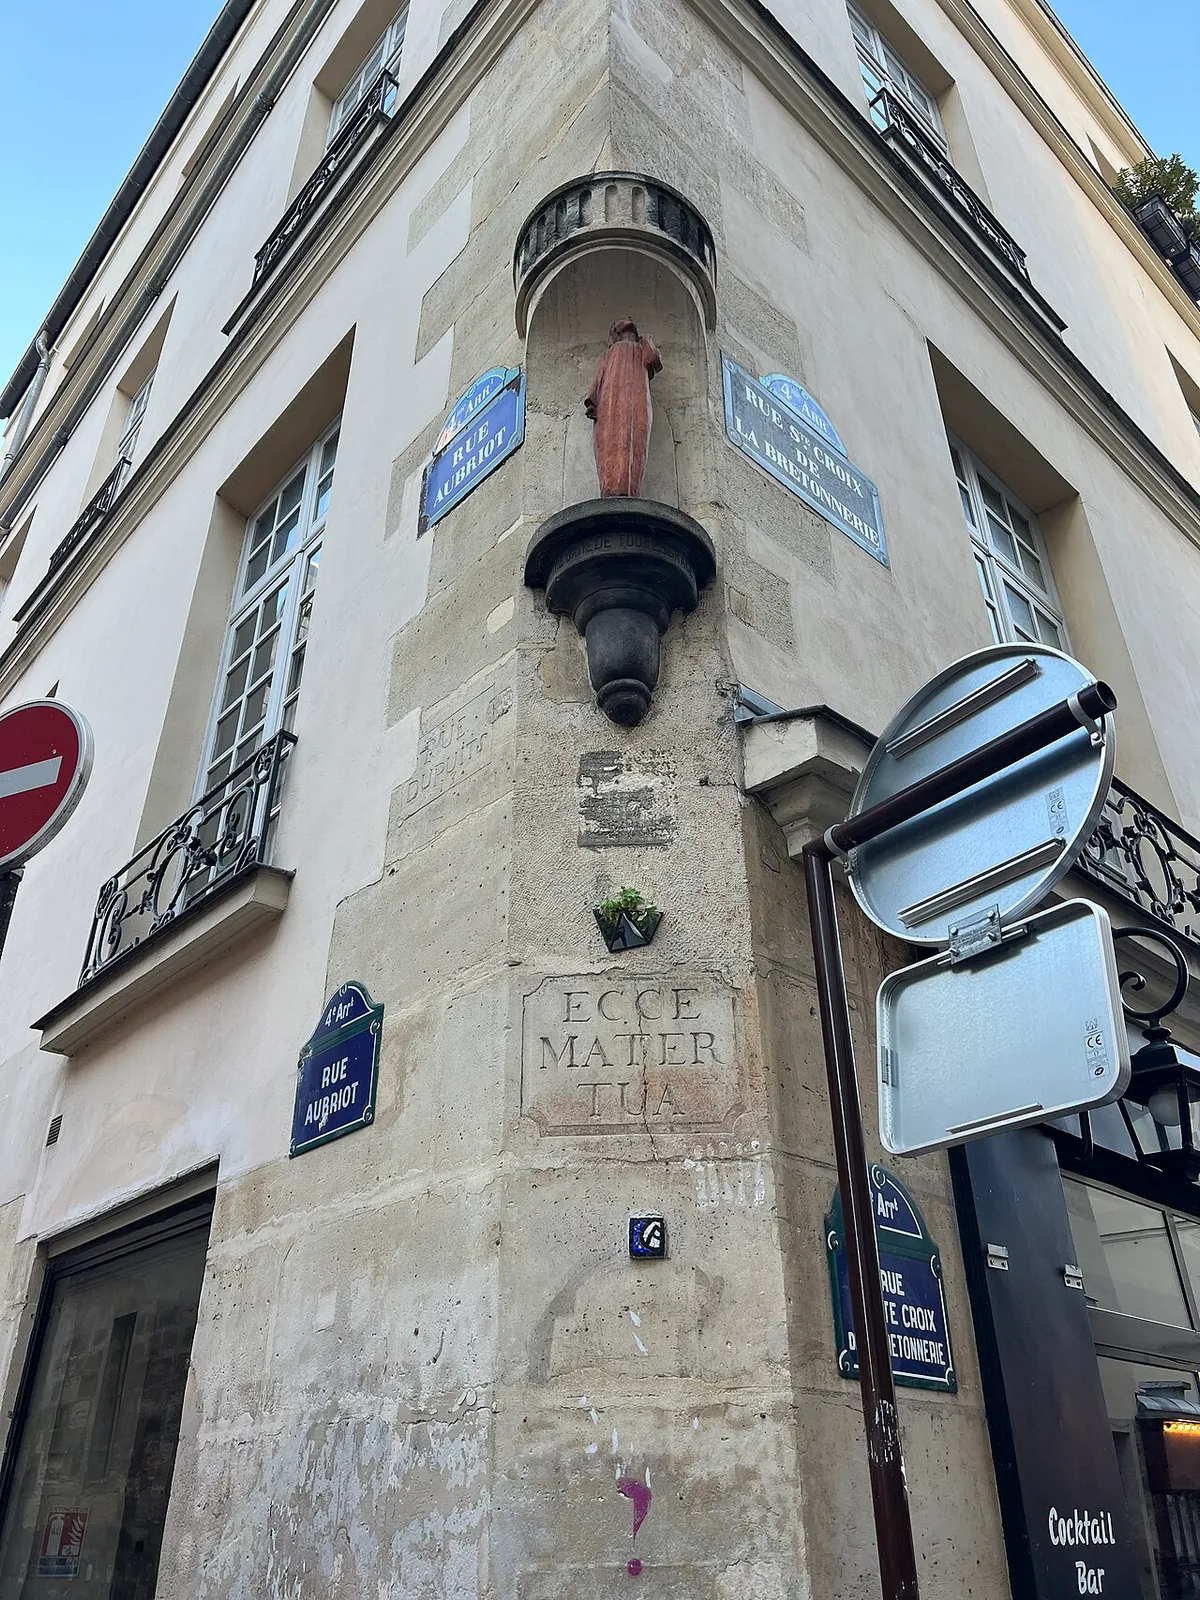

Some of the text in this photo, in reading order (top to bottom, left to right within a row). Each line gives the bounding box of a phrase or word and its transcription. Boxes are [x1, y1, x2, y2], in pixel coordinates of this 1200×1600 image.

[452, 420, 489, 469] RUE
[744, 385, 784, 430] RUE
[813, 444, 864, 499] CROIX
[432, 425, 506, 508] AUBRIOT
[735, 416, 880, 547] LA BRETONNERIE
[796, 447, 820, 480] DE
[562, 988, 701, 1022] ECCE
[539, 1032, 726, 1069] MATER
[321, 1056, 349, 1089] RUE
[304, 1081, 358, 1126] AUBRIOT
[577, 1082, 685, 1118] TUA
[877, 1192, 899, 1220] Arrt
[901, 1304, 937, 1333] CROIX
[888, 1334, 946, 1366] ETONNERIE
[1049, 1506, 1116, 1546] Cocktail
[1075, 1560, 1105, 1595] Bar
